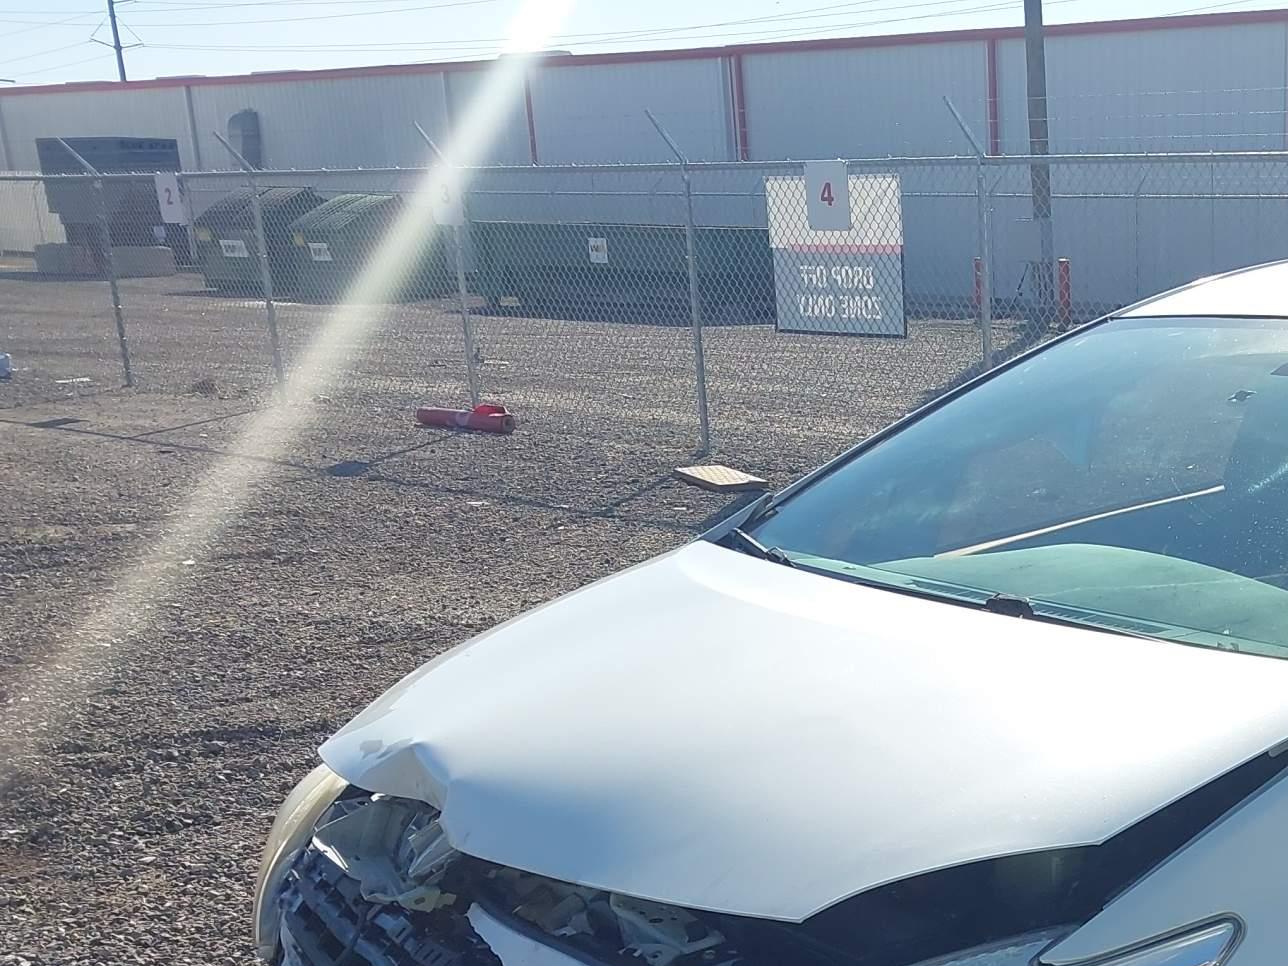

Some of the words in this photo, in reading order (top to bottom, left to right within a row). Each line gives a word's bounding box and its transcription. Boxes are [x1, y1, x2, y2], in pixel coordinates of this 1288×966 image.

[165, 187, 174, 206] 2
[440, 184, 450, 203] 3
[820, 182, 834, 206] 4
